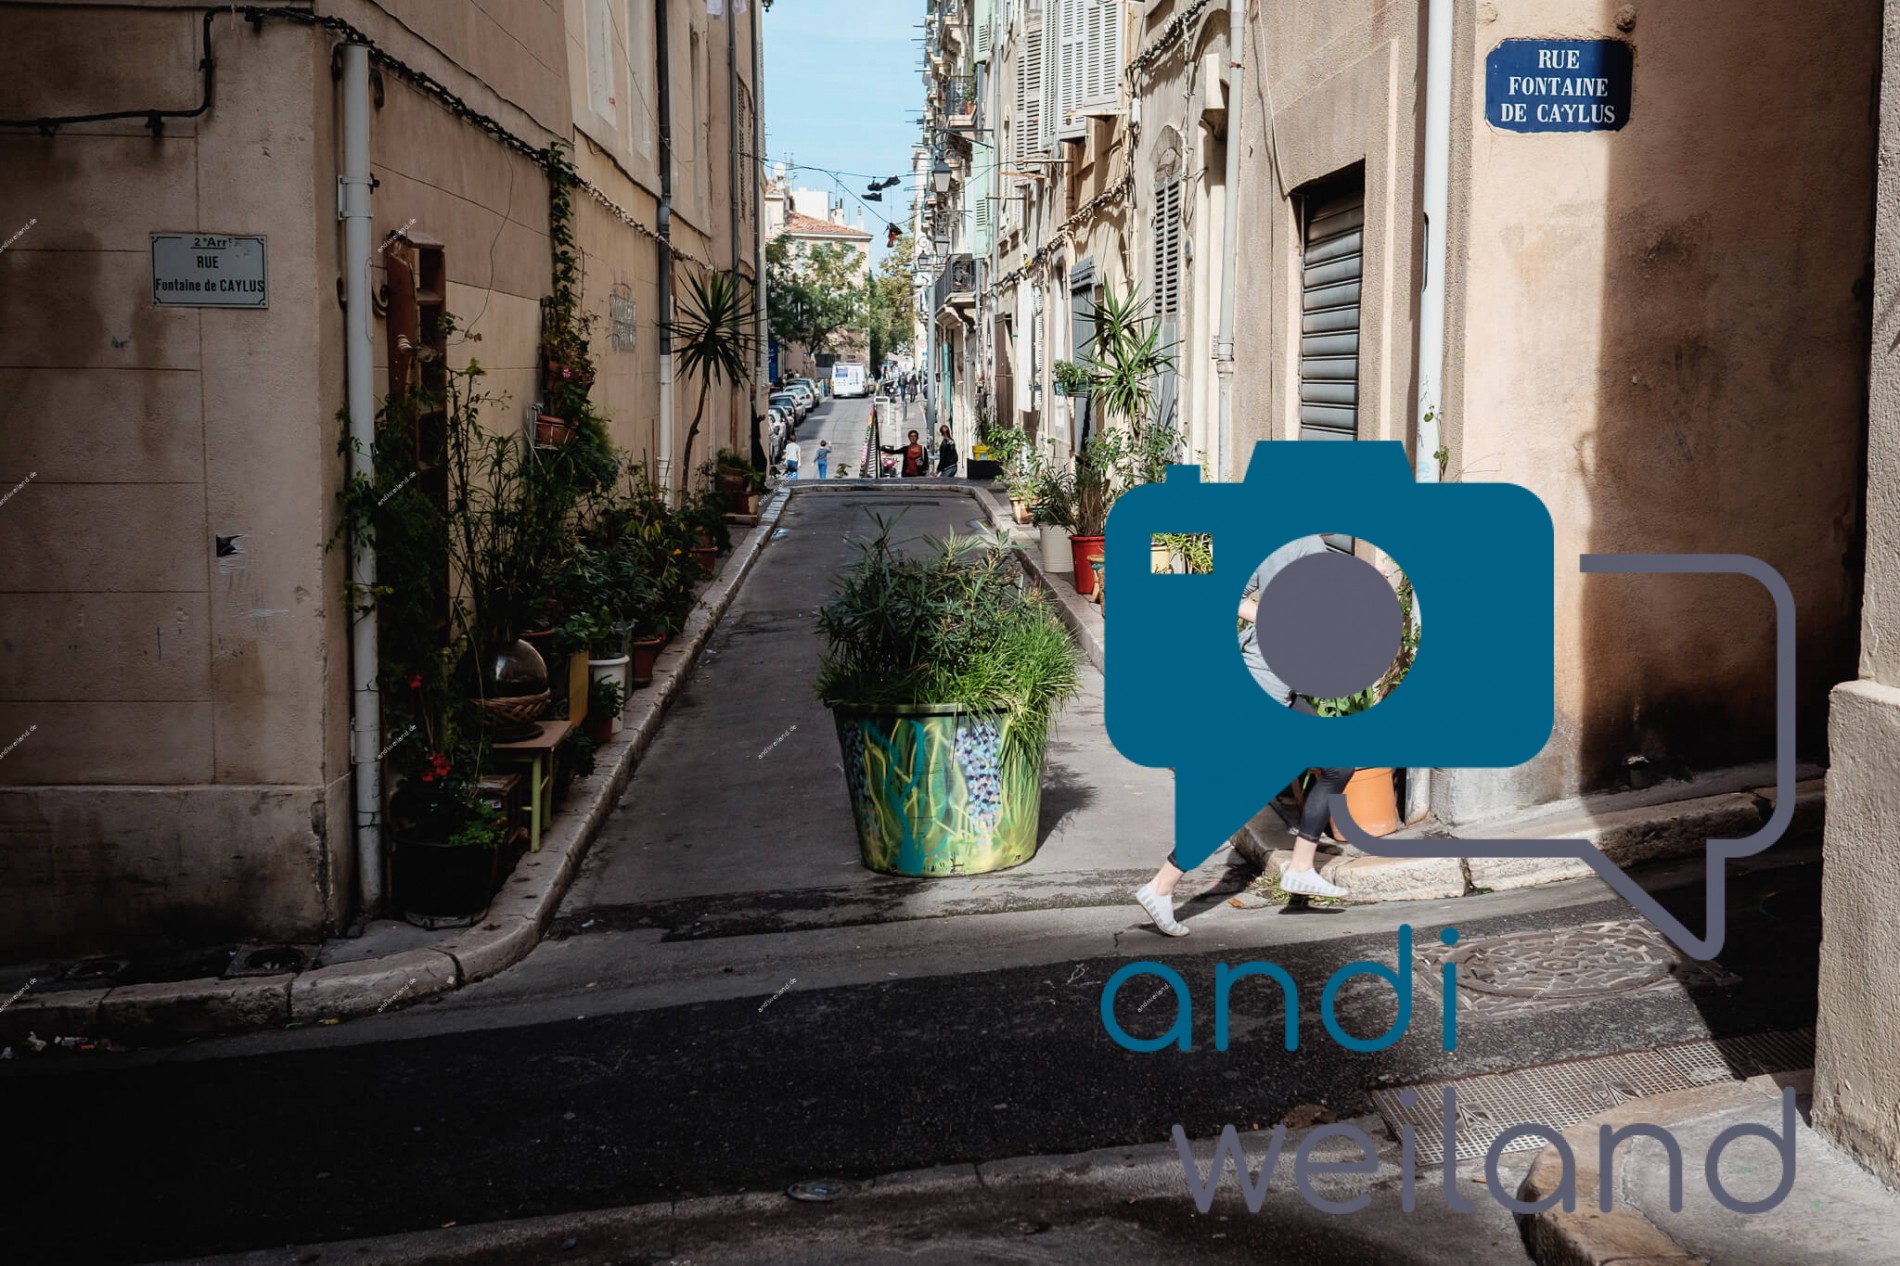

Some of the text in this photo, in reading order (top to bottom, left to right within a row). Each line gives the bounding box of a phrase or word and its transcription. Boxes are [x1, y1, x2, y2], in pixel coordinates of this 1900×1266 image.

[1538, 49, 1580, 69] RUE
[1508, 76, 1609, 97] FONTAINE
[1501, 103, 1616, 124] DE CAYLUS
[197, 255, 219, 269] RUE
[155, 278, 265, 292] Fontaine de CAYLUS
